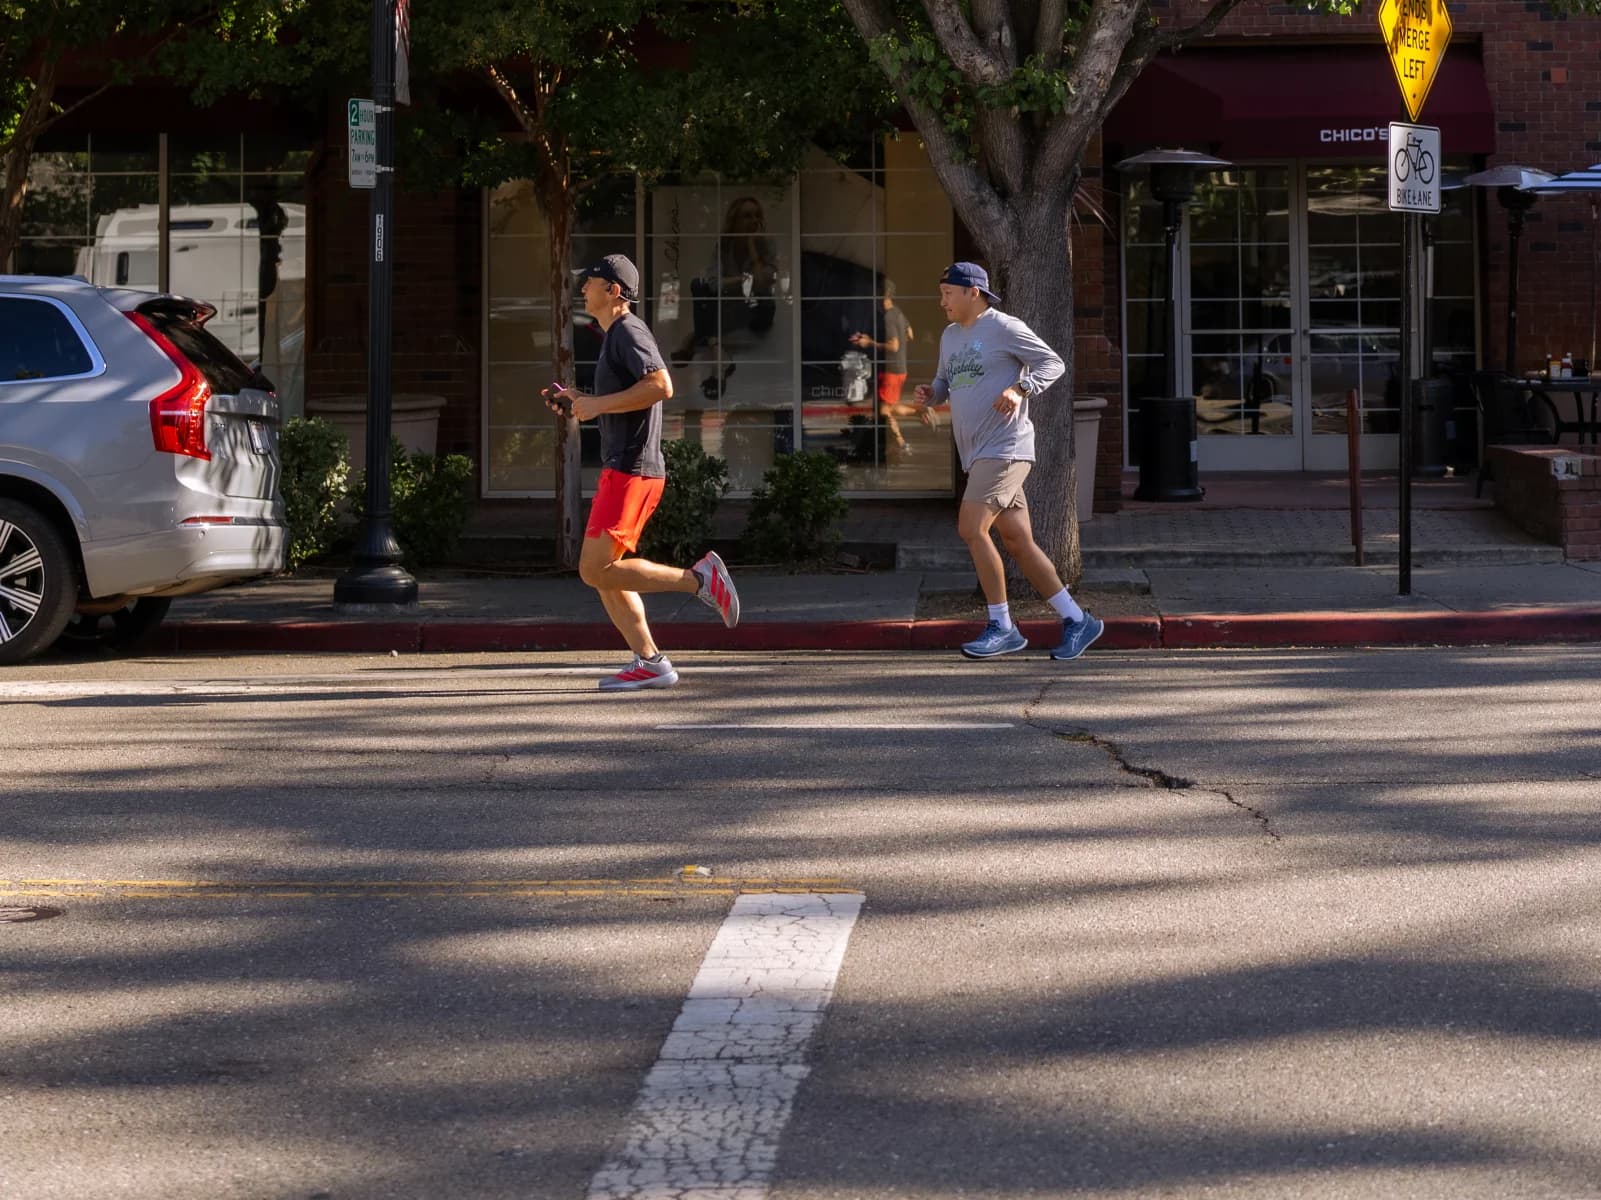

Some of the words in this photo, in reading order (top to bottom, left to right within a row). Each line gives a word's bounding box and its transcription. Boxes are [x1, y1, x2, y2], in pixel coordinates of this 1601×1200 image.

[1400, 27, 1430, 51] MERGE
[1403, 57, 1426, 81] LEFT
[351, 103, 358, 123] 2
[359, 107, 375, 123] HOUR
[350, 128, 375, 146] PARKING
[1319, 126, 1389, 142] CHICO'S
[1396, 188, 1412, 205] BIKE
[1413, 190, 1433, 207] LANE
